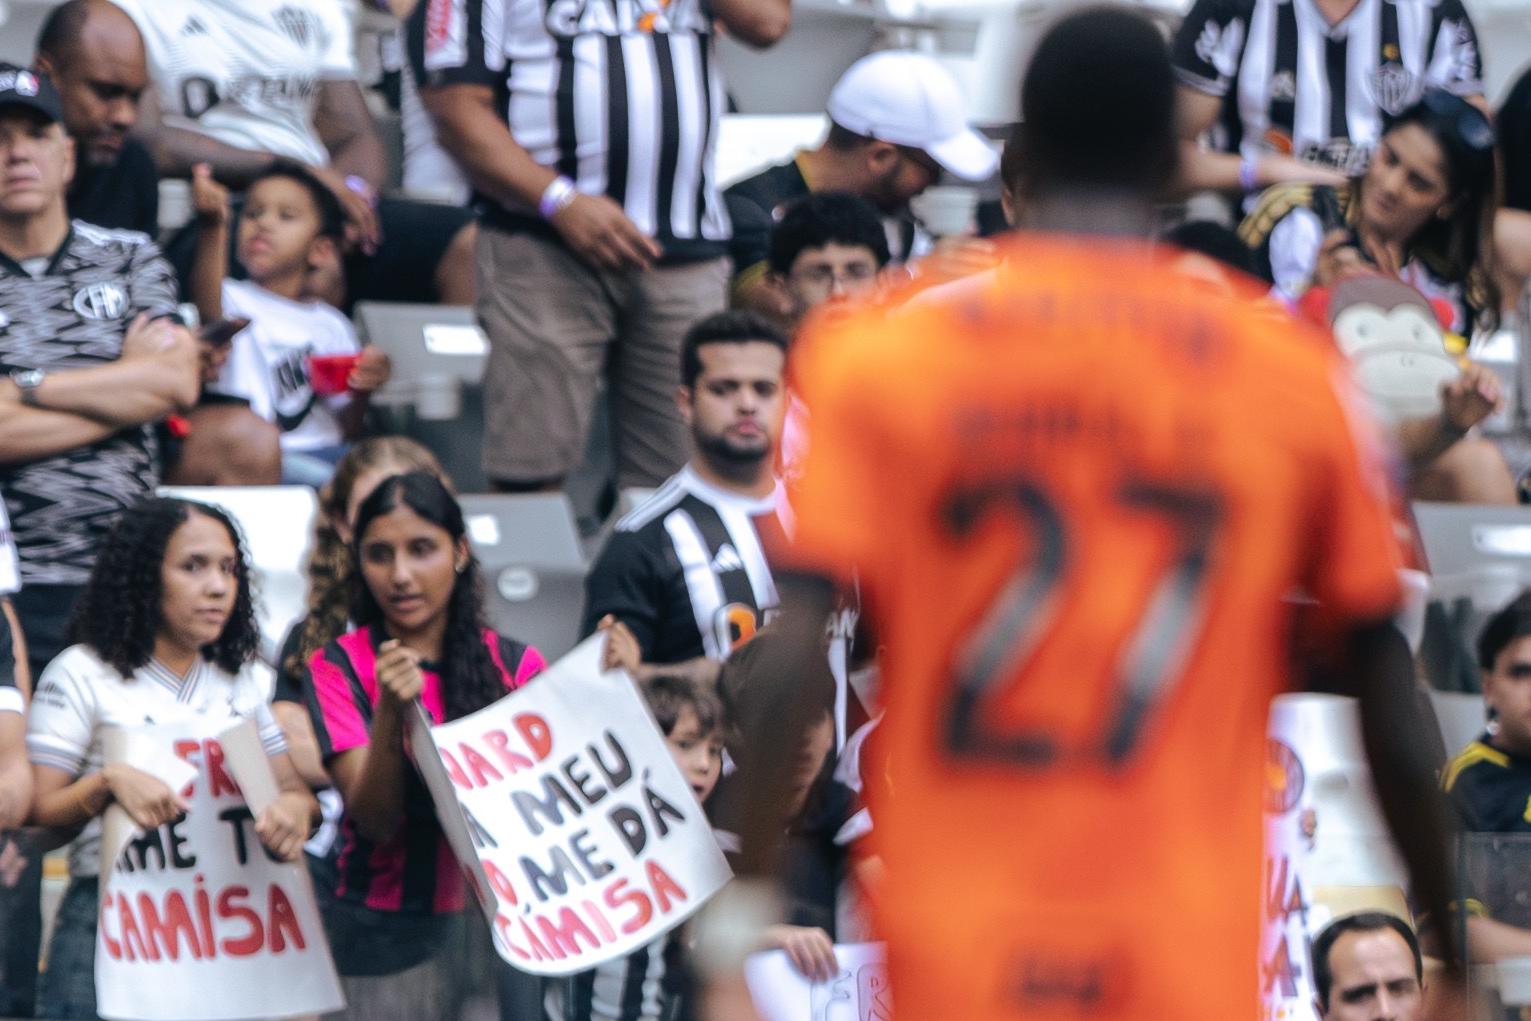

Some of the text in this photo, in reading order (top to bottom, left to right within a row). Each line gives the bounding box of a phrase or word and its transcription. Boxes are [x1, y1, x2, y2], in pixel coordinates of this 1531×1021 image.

[933, 476, 1232, 768] 27
[510, 729, 633, 837] MEU
[518, 828, 615, 903] ME
